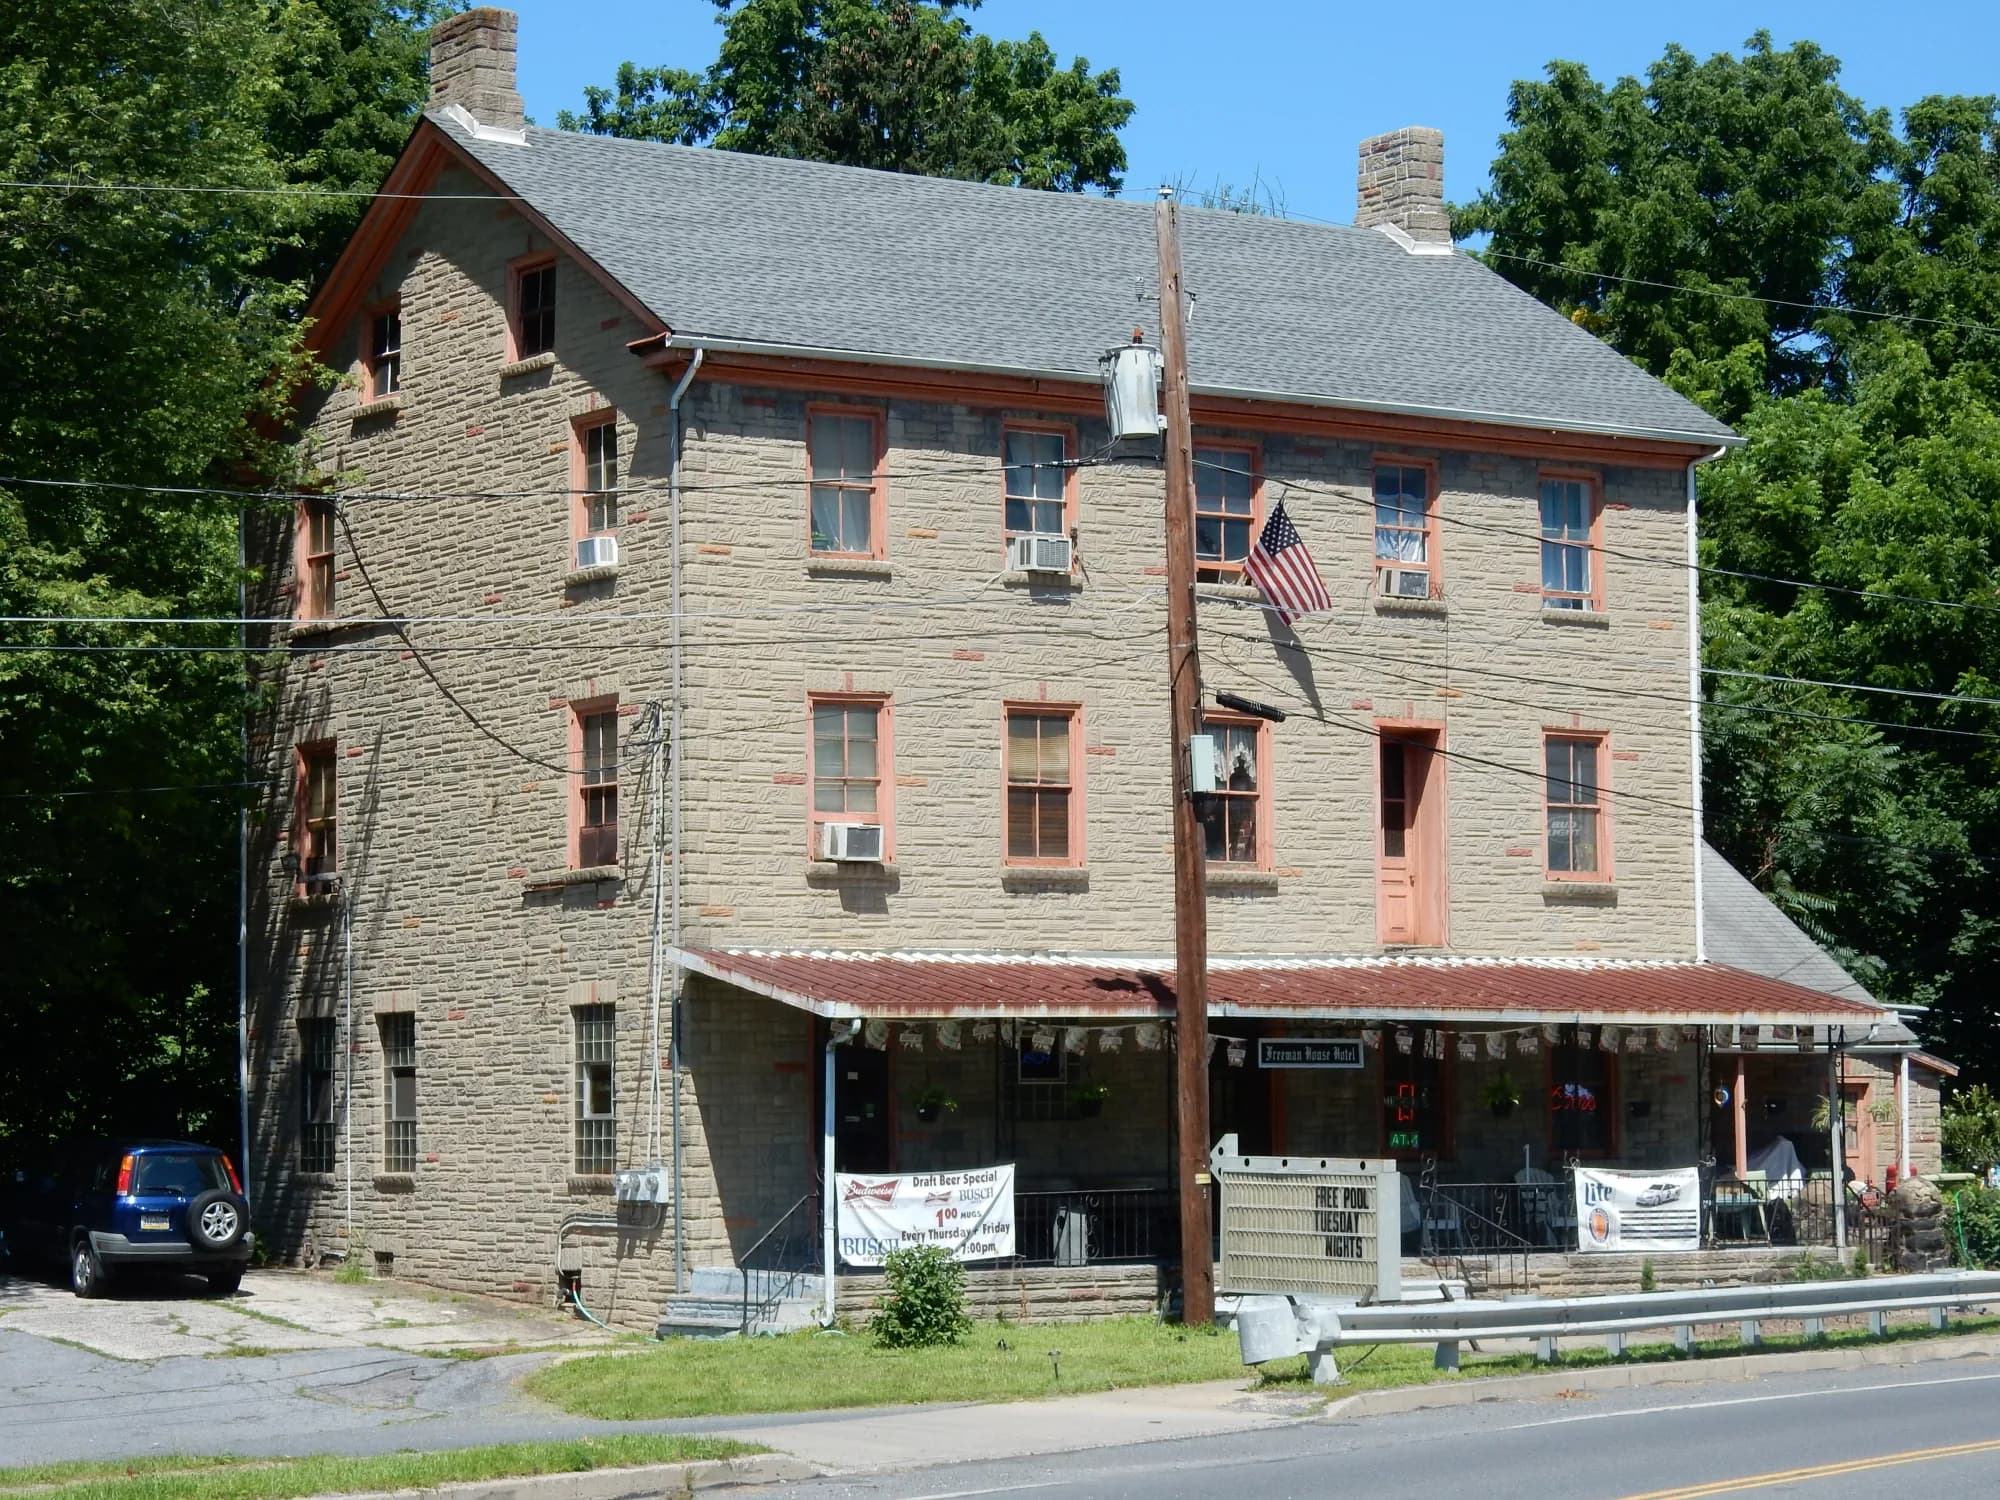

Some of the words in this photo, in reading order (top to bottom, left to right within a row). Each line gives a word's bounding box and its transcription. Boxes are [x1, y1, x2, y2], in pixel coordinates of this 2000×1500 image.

[1305, 1046, 1331, 1061] House
[1333, 1046, 1356, 1061] Hotel
[912, 1174, 937, 1187] Draft
[939, 1174, 961, 1186] Beer
[963, 1170, 998, 1186] Special
[959, 1187, 994, 1201] BUSCH
[1315, 1186, 1339, 1209] FREE
[1343, 1187, 1370, 1210] POOL
[1584, 1182, 1613, 1207] Lite
[901, 1230, 926, 1243] Every
[928, 1226, 972, 1240] Thursday
[982, 1221, 1011, 1235] Friday
[1313, 1210, 1360, 1233] TUESDAY
[840, 1236, 899, 1256] BUSCH
[961, 1241, 996, 1256] 7:00pm
[1325, 1235, 1363, 1258] NIGHTS
